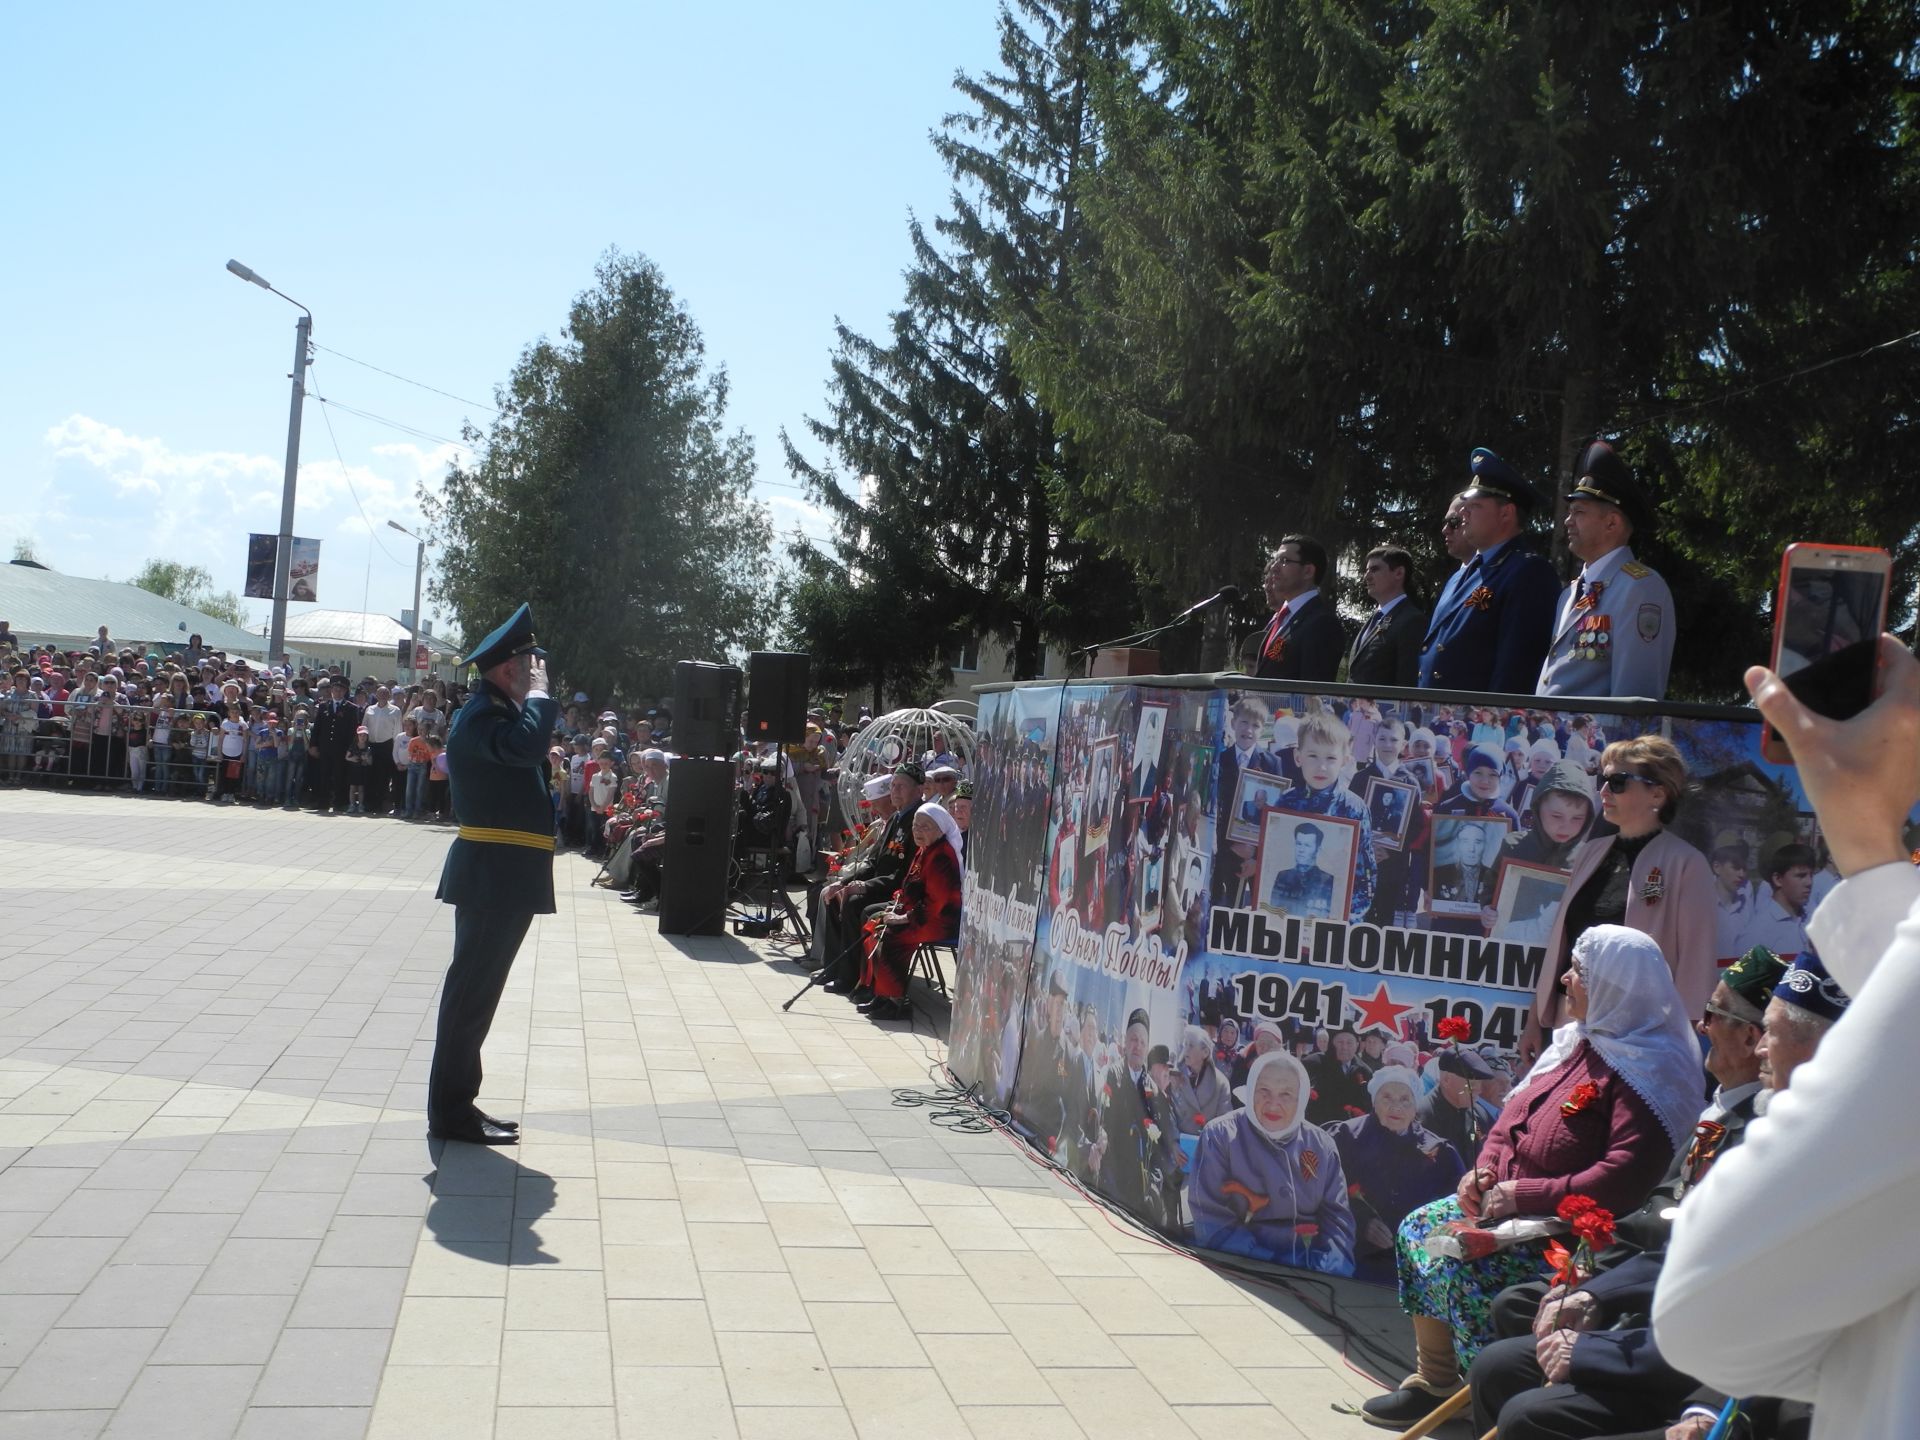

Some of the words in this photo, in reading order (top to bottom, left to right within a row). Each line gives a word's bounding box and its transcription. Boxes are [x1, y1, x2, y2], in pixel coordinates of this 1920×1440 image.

[1051, 911, 1063, 948] С
[1063, 913, 1101, 961] Днем
[1104, 930, 1184, 990] Победы!
[1210, 910, 1301, 960] МЫ
[1312, 922, 1546, 988] ПОМНИМ
[1235, 974, 1344, 1027] 1941
